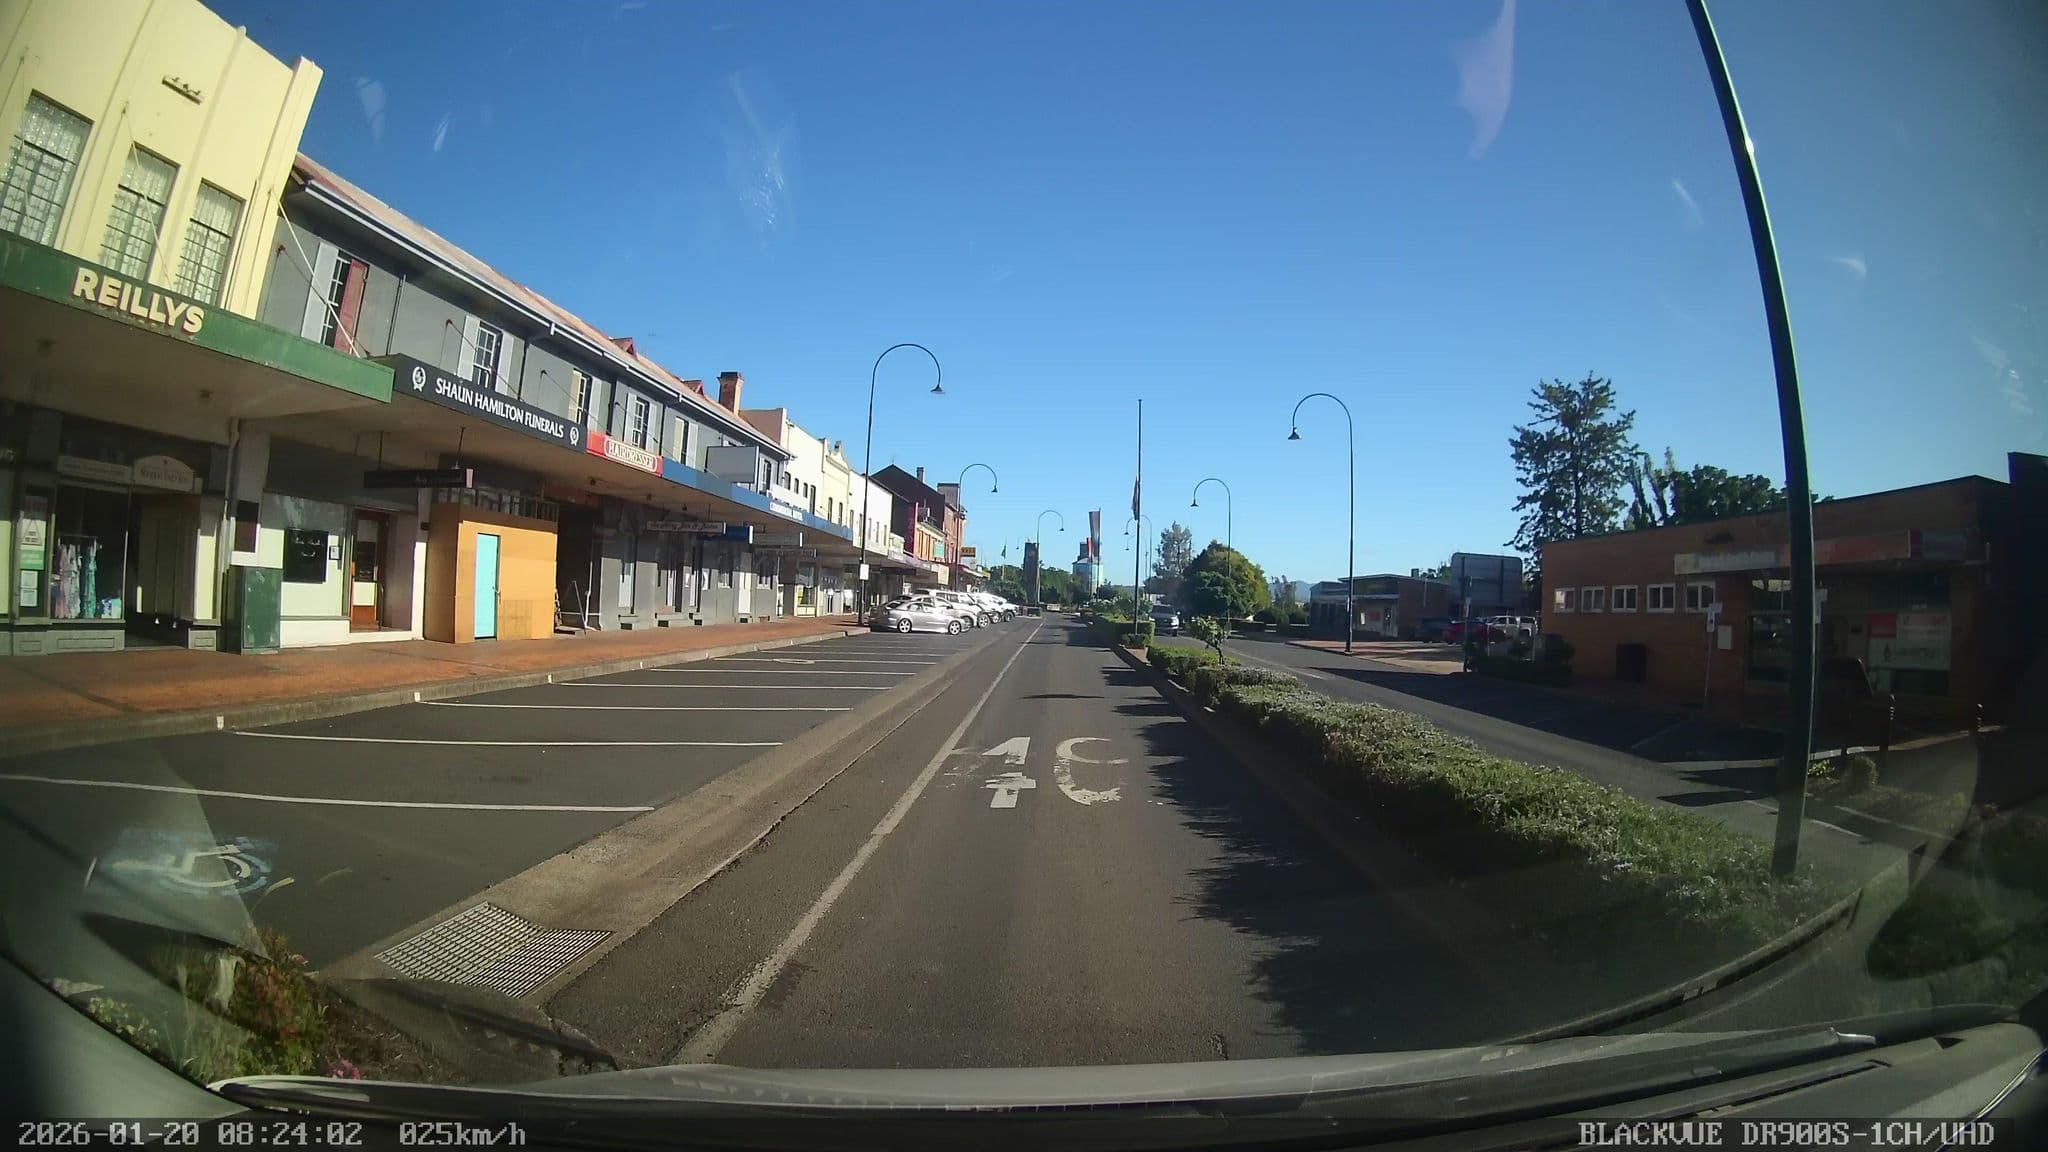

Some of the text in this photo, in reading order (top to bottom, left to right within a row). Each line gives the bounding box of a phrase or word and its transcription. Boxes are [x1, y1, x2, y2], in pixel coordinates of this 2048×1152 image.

[73, 267, 205, 334] REILLYS
[435, 377, 565, 439] SHAUN HAMILTON FUNERALS
[608, 441, 654, 470] HAIRDRESSER
